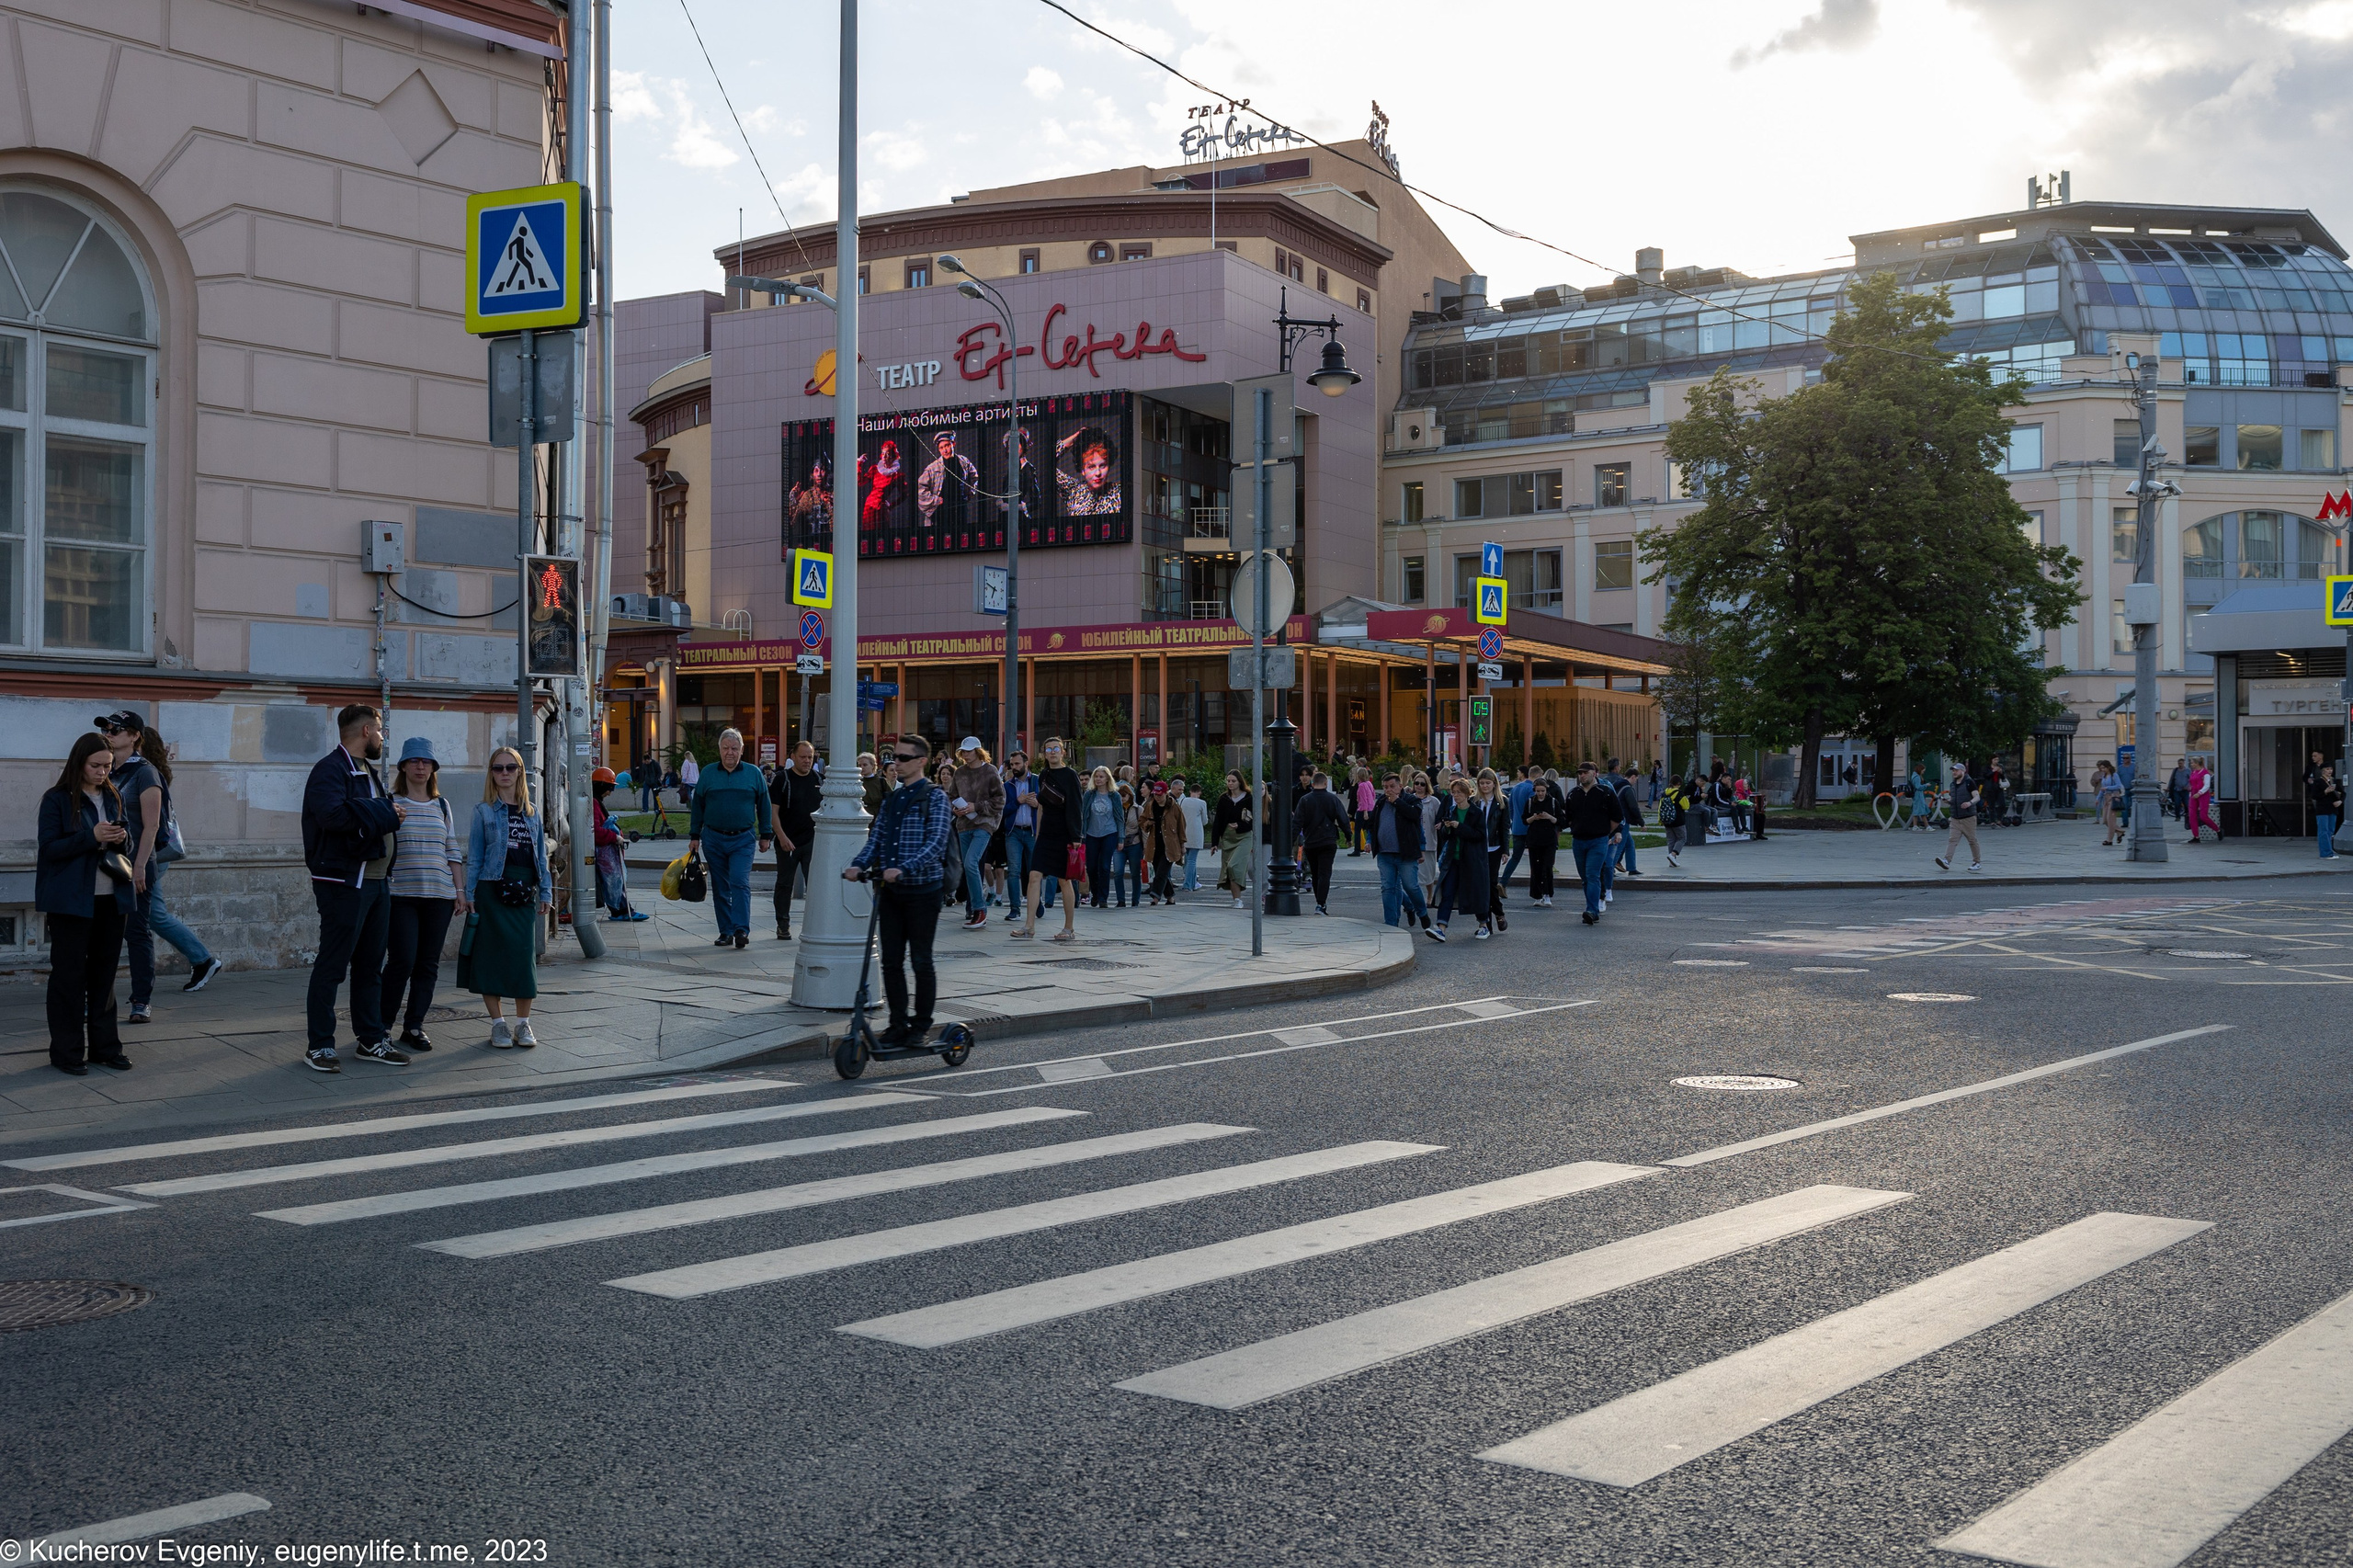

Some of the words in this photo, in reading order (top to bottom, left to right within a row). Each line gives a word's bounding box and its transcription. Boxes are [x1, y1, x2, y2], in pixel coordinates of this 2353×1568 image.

[1188, 98, 1251, 119] ТЕАТР
[1178, 125, 1223, 158] Et
[953, 322, 1034, 390] Et
[1041, 302, 1207, 379] Cetera
[876, 359, 943, 391] ТЕАТР
[857, 417, 894, 432] Наши
[897, 410, 971, 429] любимые
[857, 638, 908, 657] ИЛЕЙНЫЙ
[910, 633, 993, 655] ТЕАТРАЛЬНЫЙ
[995, 635, 1032, 652] СОН
[1081, 626, 1163, 647] ЮБИЛЕЙНЫЙ
[683, 644, 757, 664] ТЕАТРАЛЬНЫЙ
[758, 645, 793, 661] СЕЗОН
[1350, 709, 1365, 721] SAN
[1473, 701, 1488, 716] 09
[2271, 699, 2345, 712] ТУРГЕН
